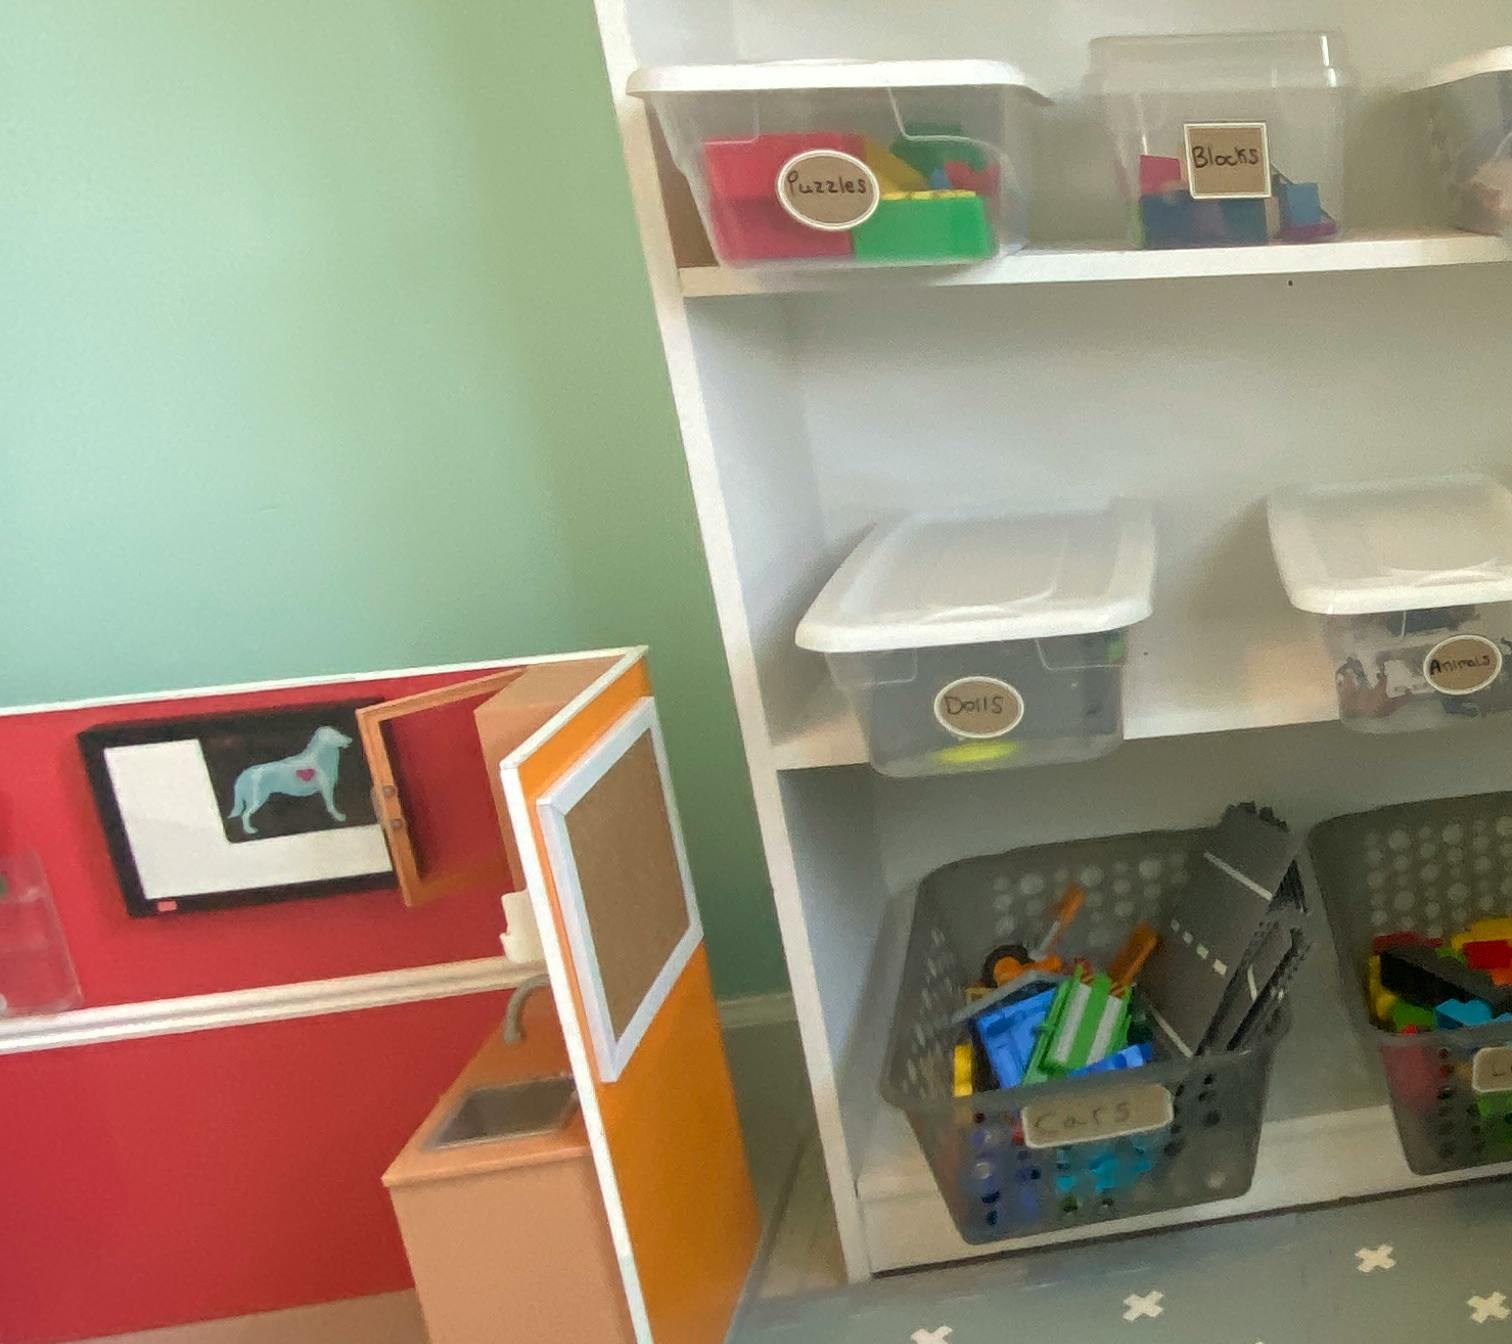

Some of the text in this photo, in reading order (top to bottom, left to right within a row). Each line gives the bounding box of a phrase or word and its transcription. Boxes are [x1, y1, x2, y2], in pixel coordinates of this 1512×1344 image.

[1191, 145, 1259, 169] Blocks
[787, 169, 867, 196] Puzzles
[944, 695, 1004, 715] Dolls
[1033, 1102, 1131, 1135] Cars
